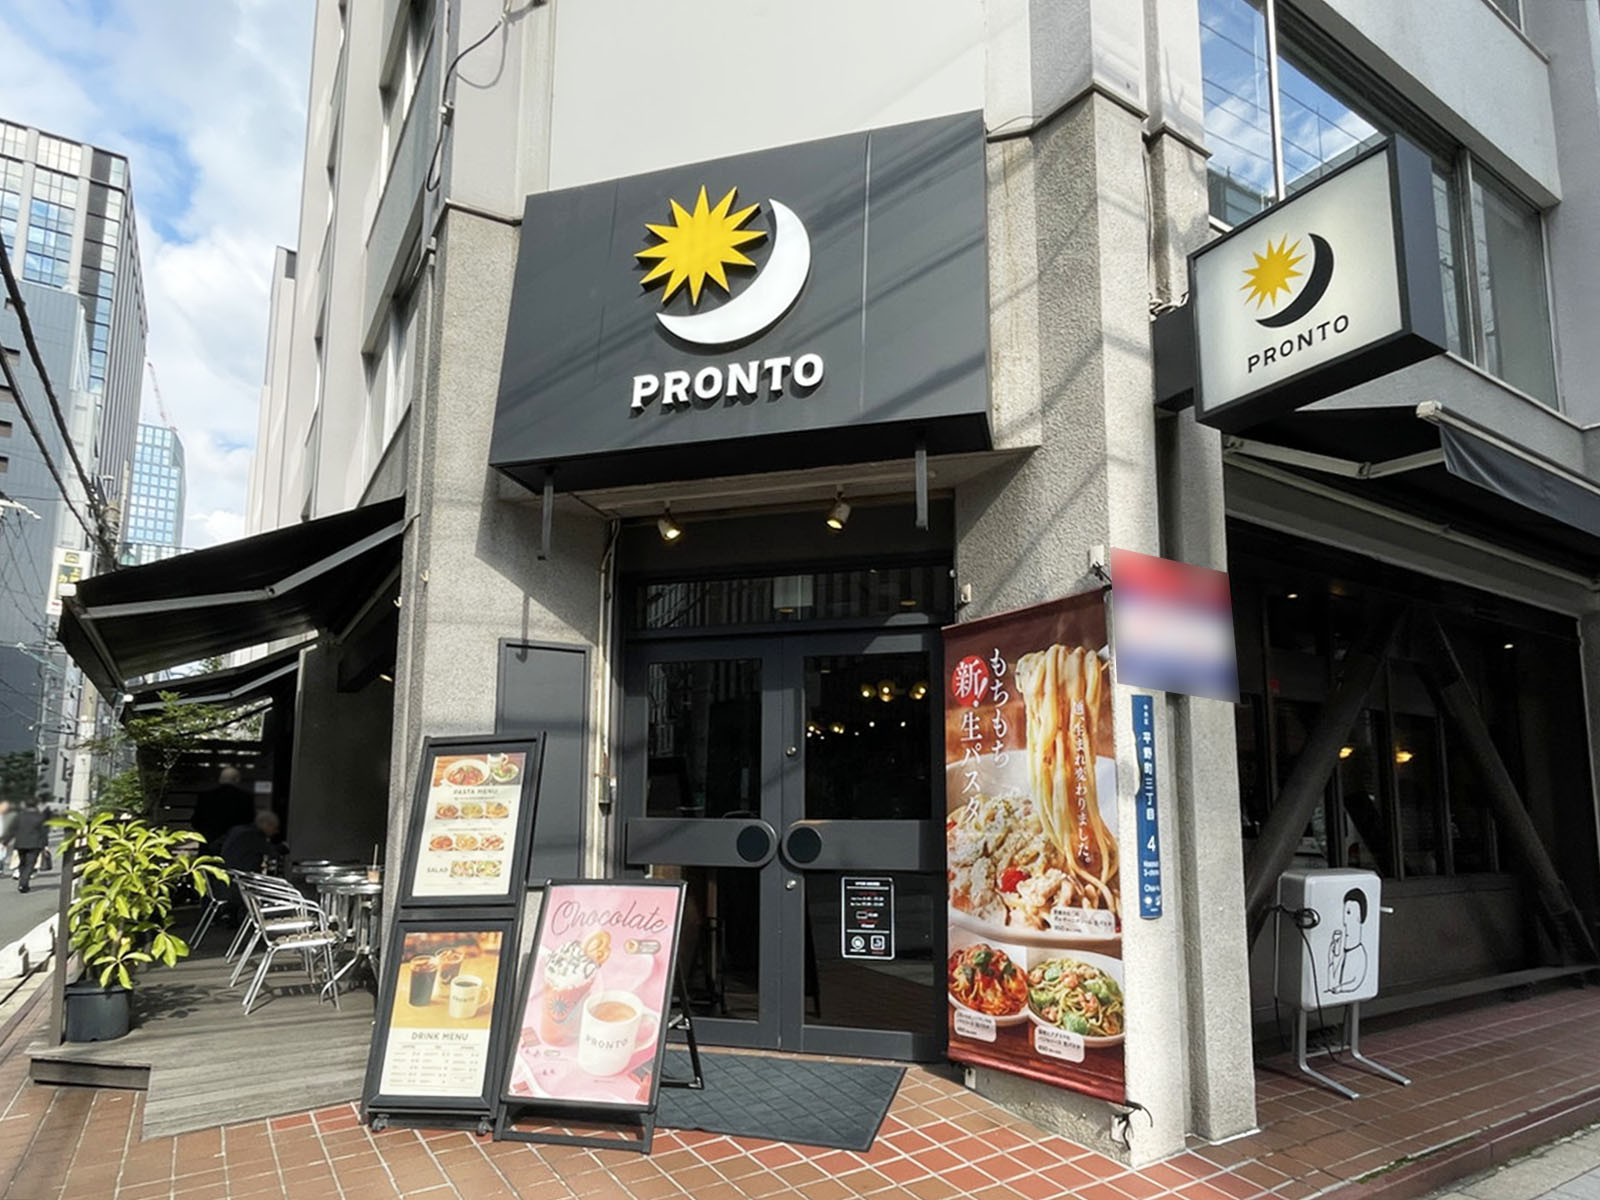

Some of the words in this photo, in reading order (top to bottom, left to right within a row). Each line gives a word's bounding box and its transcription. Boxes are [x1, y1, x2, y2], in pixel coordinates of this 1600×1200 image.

[1247, 315, 1349, 373] PRONTO
[631, 353, 824, 408] PRONTO
[989, 648, 1010, 768] もちもち
[1147, 835, 1156, 852] 4
[551, 900, 668, 936] Chocolate
[411, 1031, 441, 1041] DRINK
[442, 1031, 469, 1041] MENU
[585, 1033, 629, 1049] PRONTO
